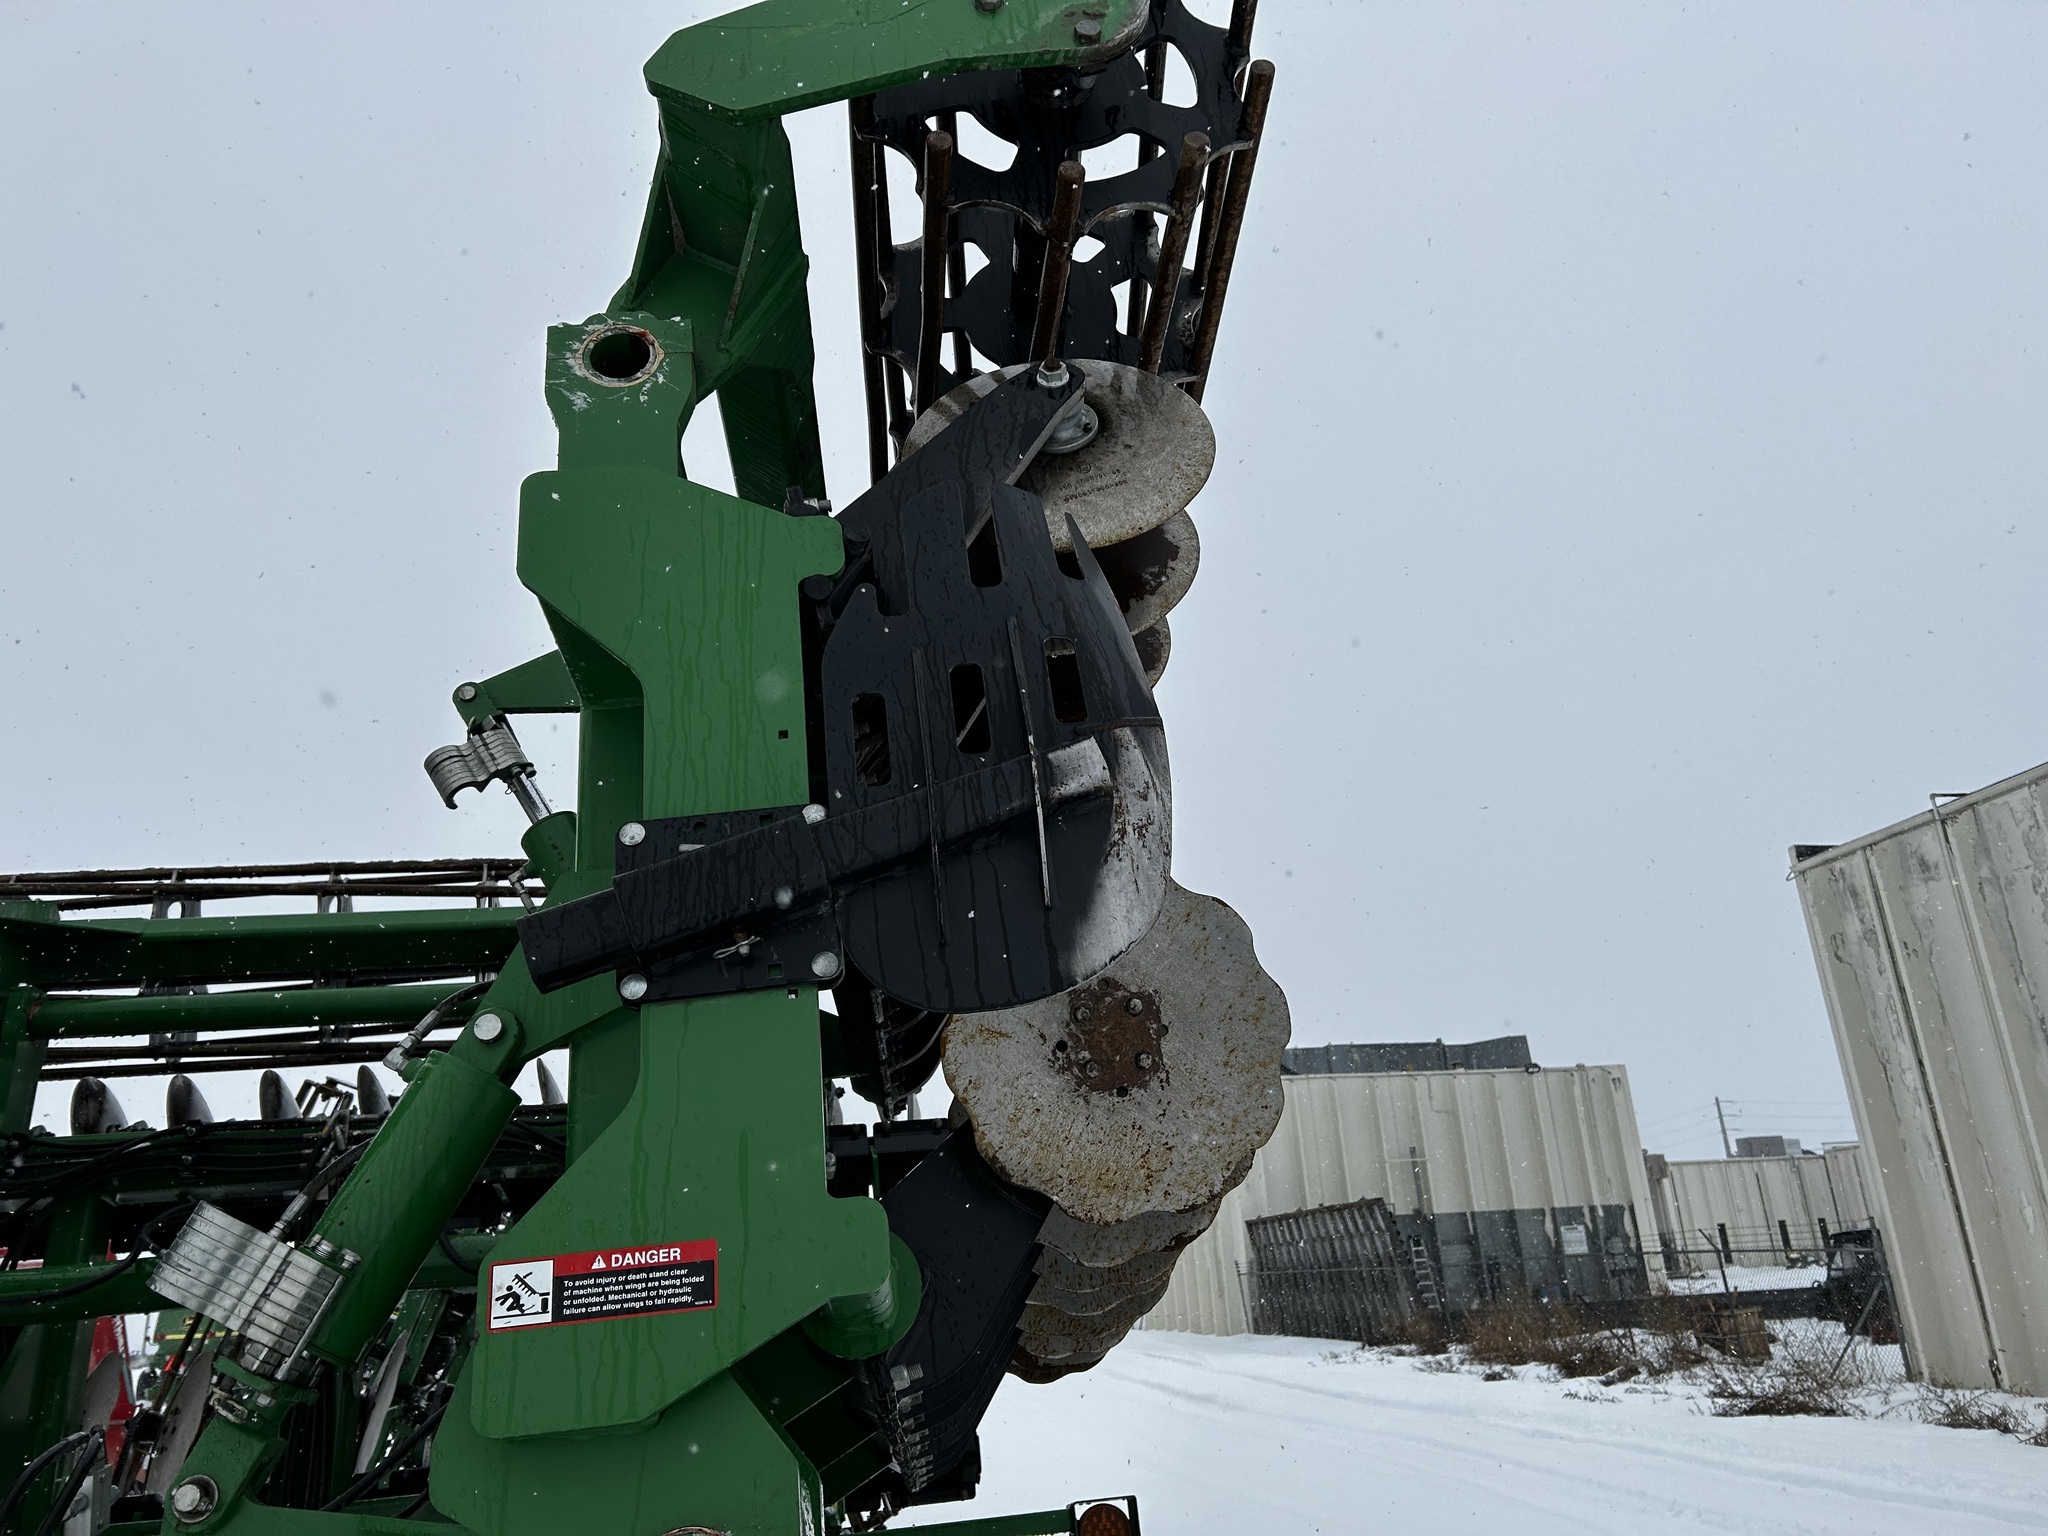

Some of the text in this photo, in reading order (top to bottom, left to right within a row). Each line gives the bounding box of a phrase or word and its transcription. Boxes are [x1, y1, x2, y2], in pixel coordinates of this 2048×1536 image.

[611, 1247, 681, 1267] DANGER
[563, 1289, 571, 1297] of
[572, 1287, 603, 1295] machine
[625, 1282, 647, 1290] wings
[660, 1278, 681, 1286] being
[682, 1275, 704, 1284] folded
[574, 1278, 594, 1286] avoid
[596, 1277, 617, 1285] injury
[627, 1272, 647, 1280] death
[649, 1270, 669, 1278] stand
[563, 1307, 586, 1315] failure
[623, 1301, 644, 1309] wings
[654, 1297, 666, 1305] fall
[667, 1295, 694, 1304] rapidly.
[573, 1295, 607, 1305] unfolded.
[608, 1290, 648, 1301] Mechanical
[659, 1286, 692, 1297] hydraulic
